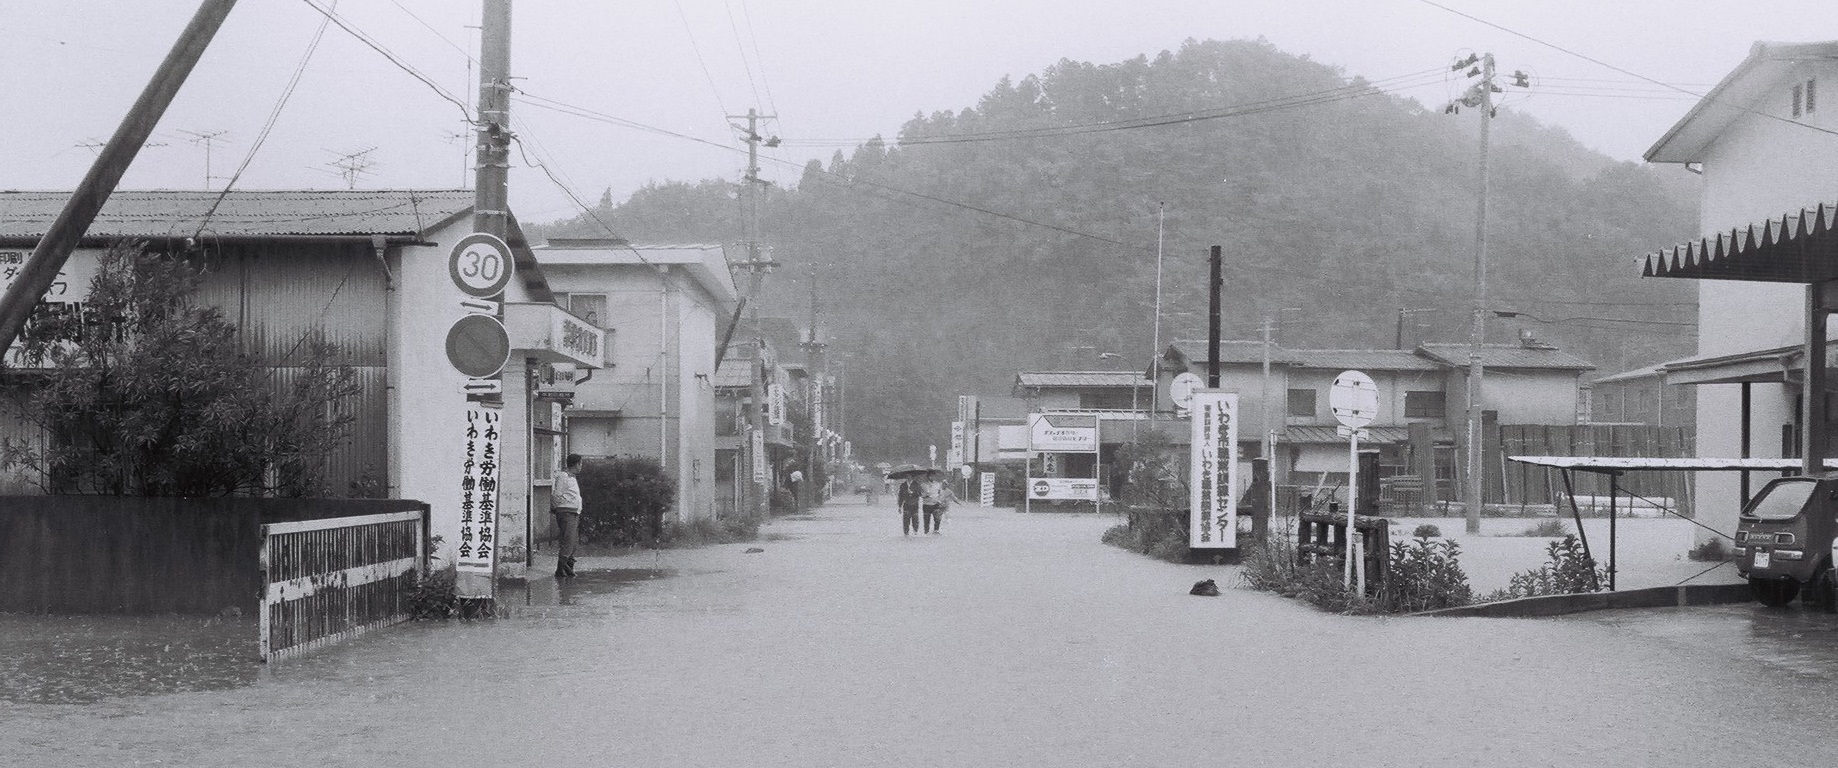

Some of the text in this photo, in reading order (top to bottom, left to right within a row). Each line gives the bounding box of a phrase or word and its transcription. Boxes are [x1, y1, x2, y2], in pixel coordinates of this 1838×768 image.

[463, 251, 499, 281] 30
[459, 410, 478, 558] いわき労働基準協会
[477, 412, 499, 559] いわき労働基準協会
